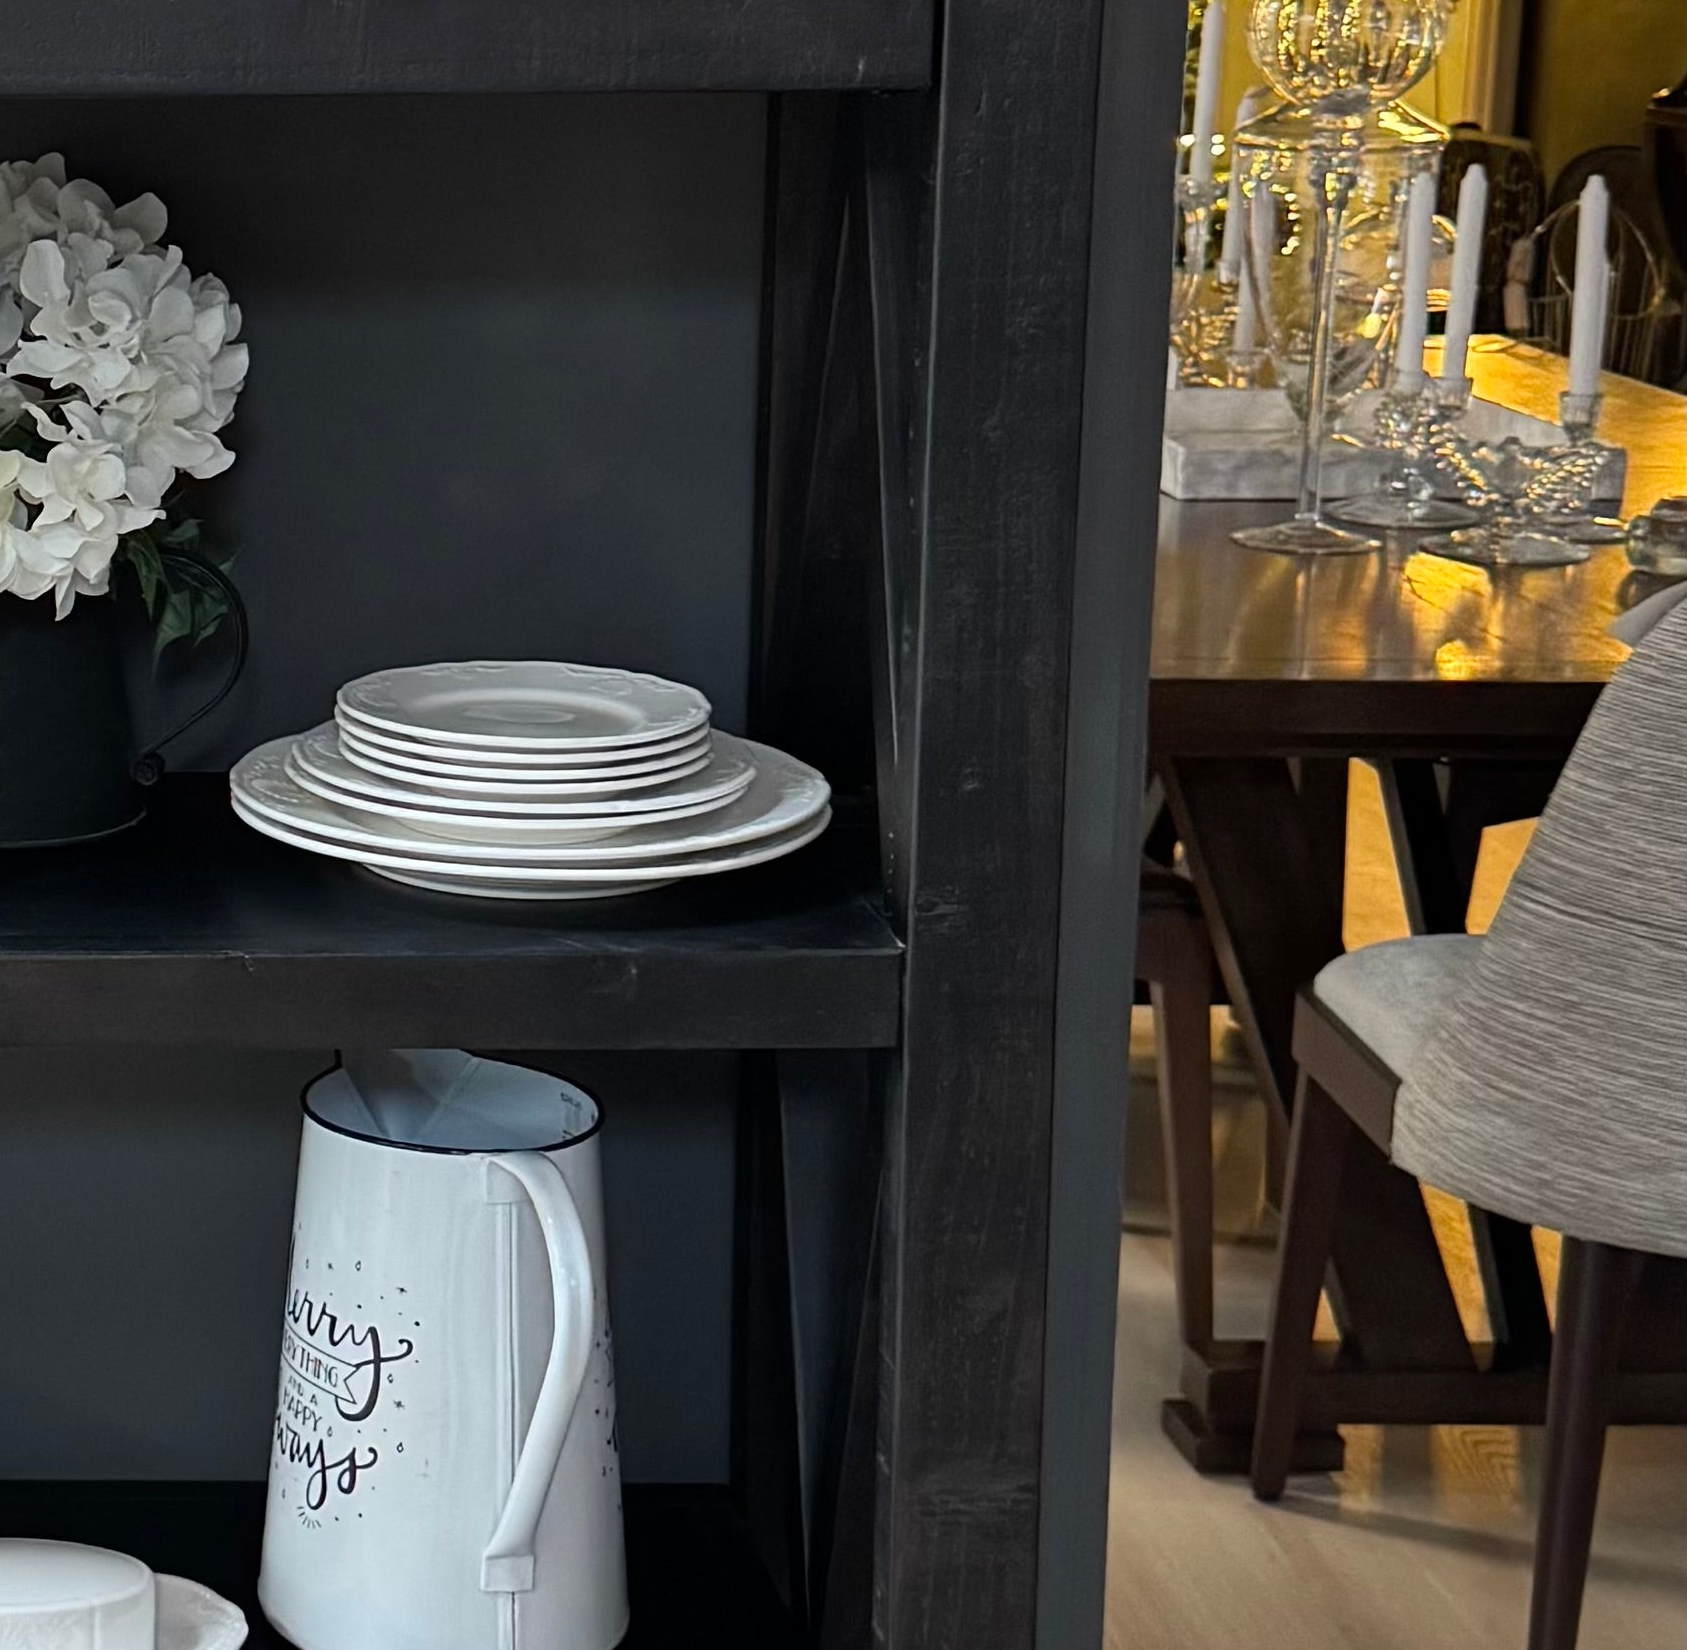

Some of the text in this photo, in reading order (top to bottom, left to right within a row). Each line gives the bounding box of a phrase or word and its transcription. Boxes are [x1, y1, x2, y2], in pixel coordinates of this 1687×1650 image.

[287, 1288, 413, 1422] erry
[282, 1386, 323, 1433] HAPPY
[309, 1393, 318, 1407] A
[274, 1411, 379, 1511] ways
